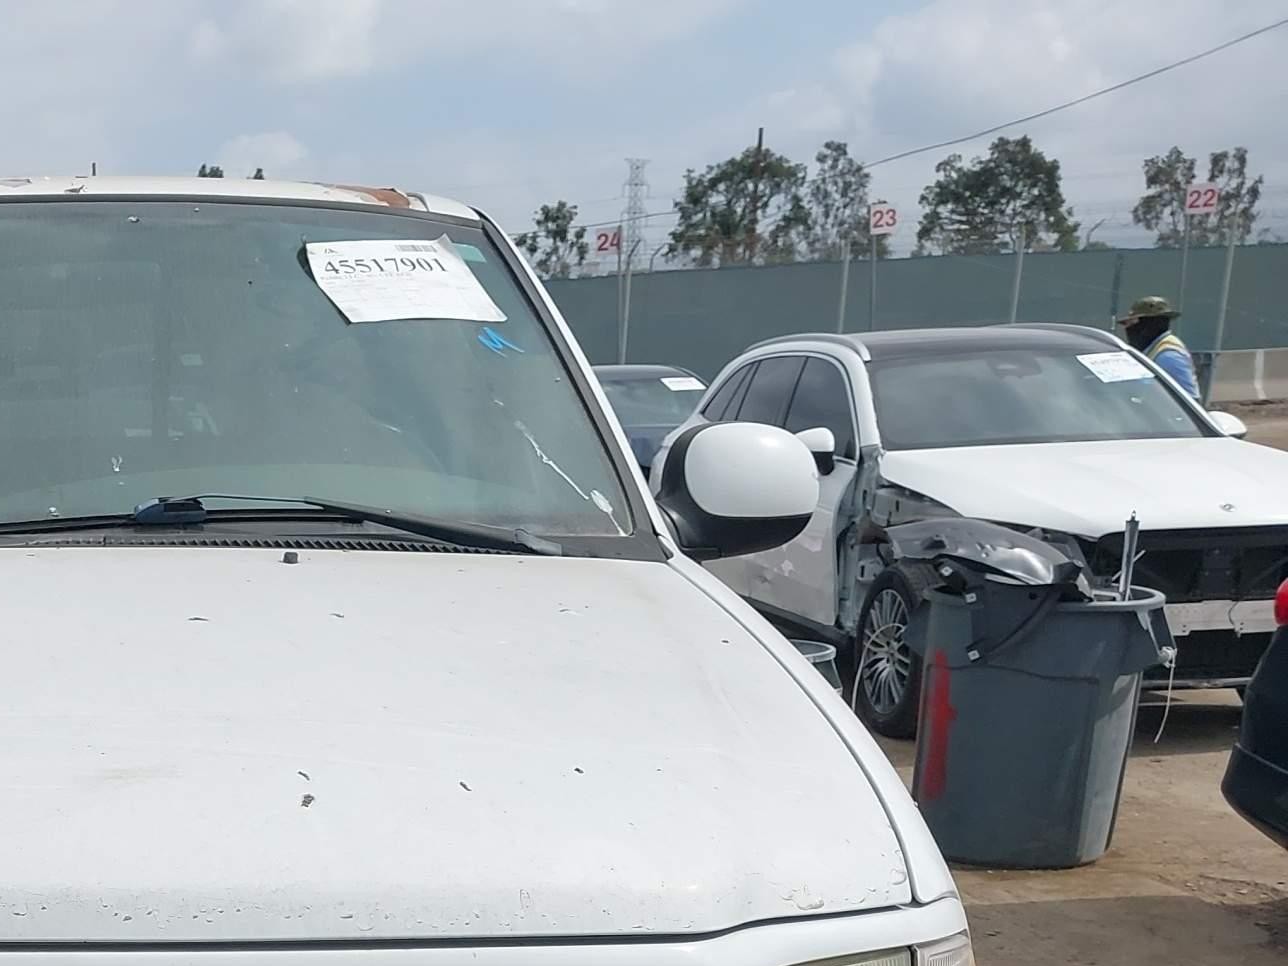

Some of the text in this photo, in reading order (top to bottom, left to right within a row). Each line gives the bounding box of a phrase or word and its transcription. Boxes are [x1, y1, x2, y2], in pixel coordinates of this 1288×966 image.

[1188, 188, 1216, 209] 22
[872, 208, 897, 228] 23
[597, 232, 621, 252] 24
[324, 257, 448, 275] 45517901
